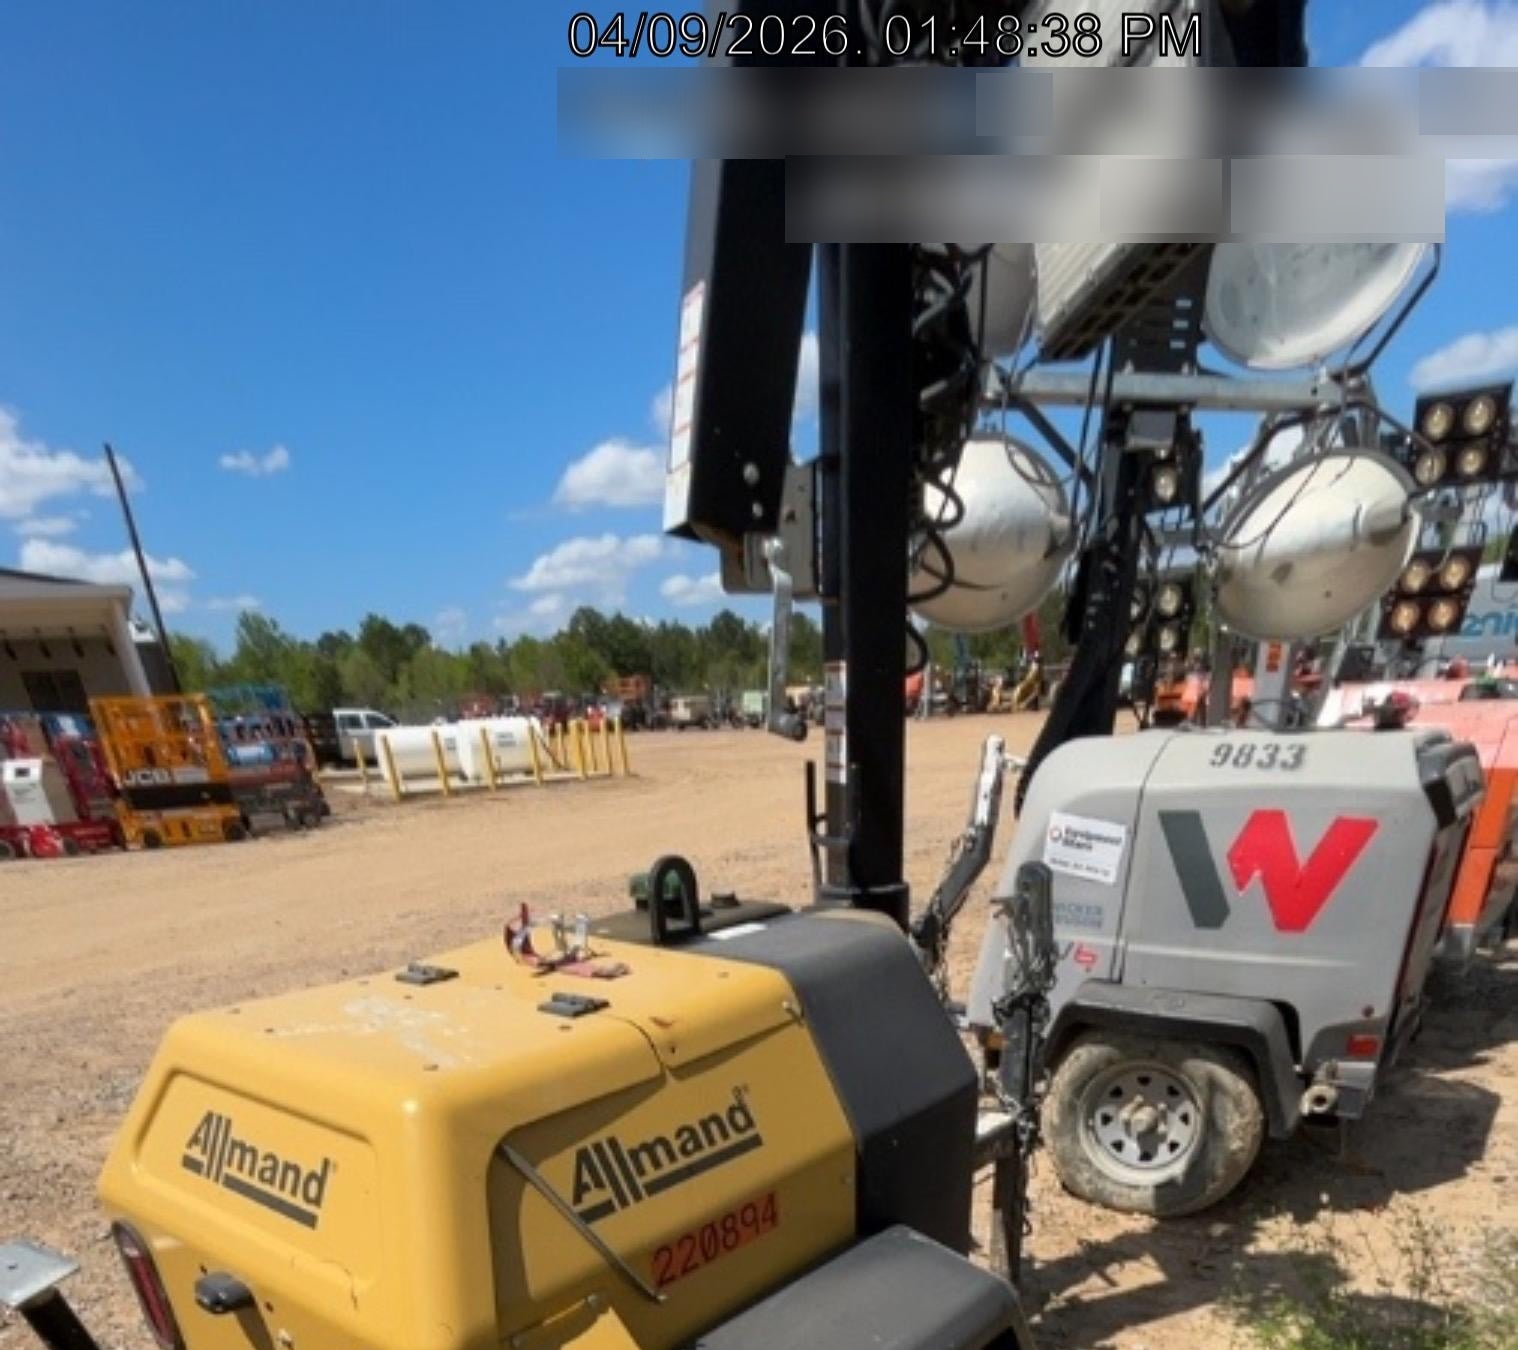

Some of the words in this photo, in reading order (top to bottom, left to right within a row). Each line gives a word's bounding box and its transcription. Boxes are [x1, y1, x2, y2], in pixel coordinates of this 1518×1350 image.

[1209, 743, 1305, 771] 9833
[185, 1109, 331, 1209] Allmand
[653, 1192, 779, 1288] 220894
